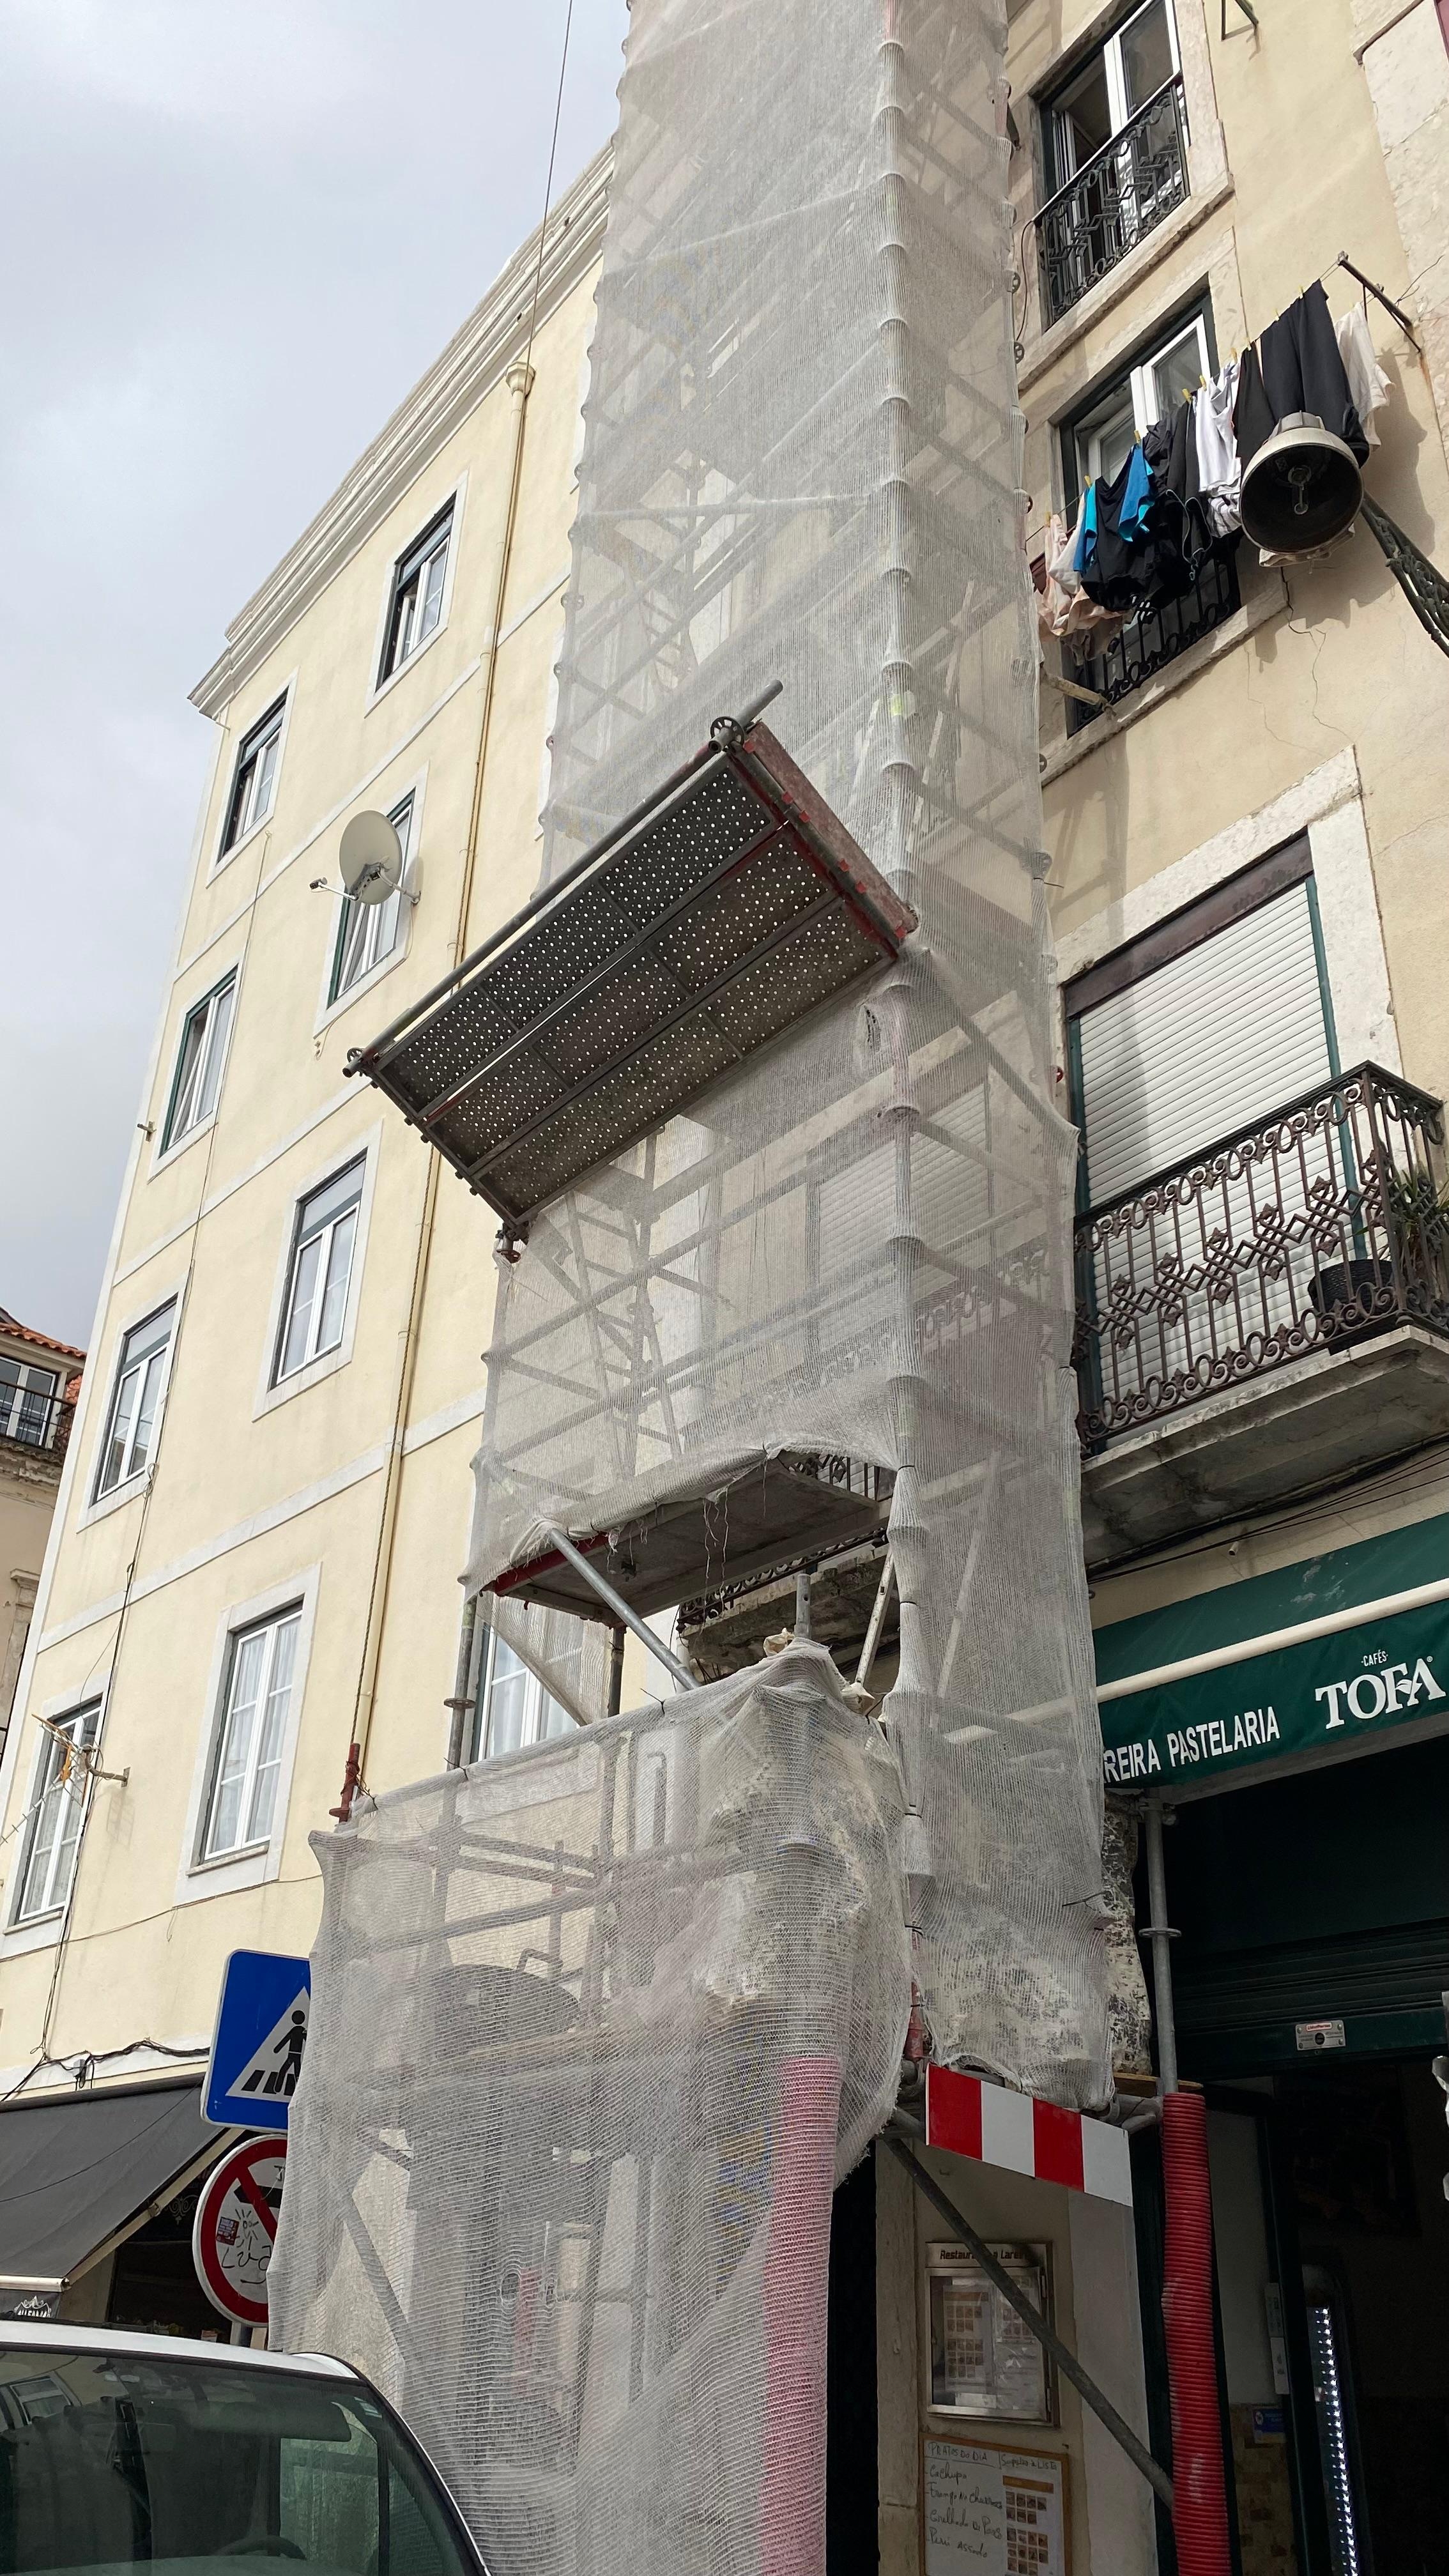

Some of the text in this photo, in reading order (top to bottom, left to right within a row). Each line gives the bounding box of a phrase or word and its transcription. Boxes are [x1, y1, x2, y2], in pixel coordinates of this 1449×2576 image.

[1361, 1649, 1388, 1667] CAFÉS
[1315, 1657, 1446, 1729] TOFA
[1103, 1706, 1280, 1783] REIRA PASTELARIA
[940, 2250, 975, 2260] Restaur
